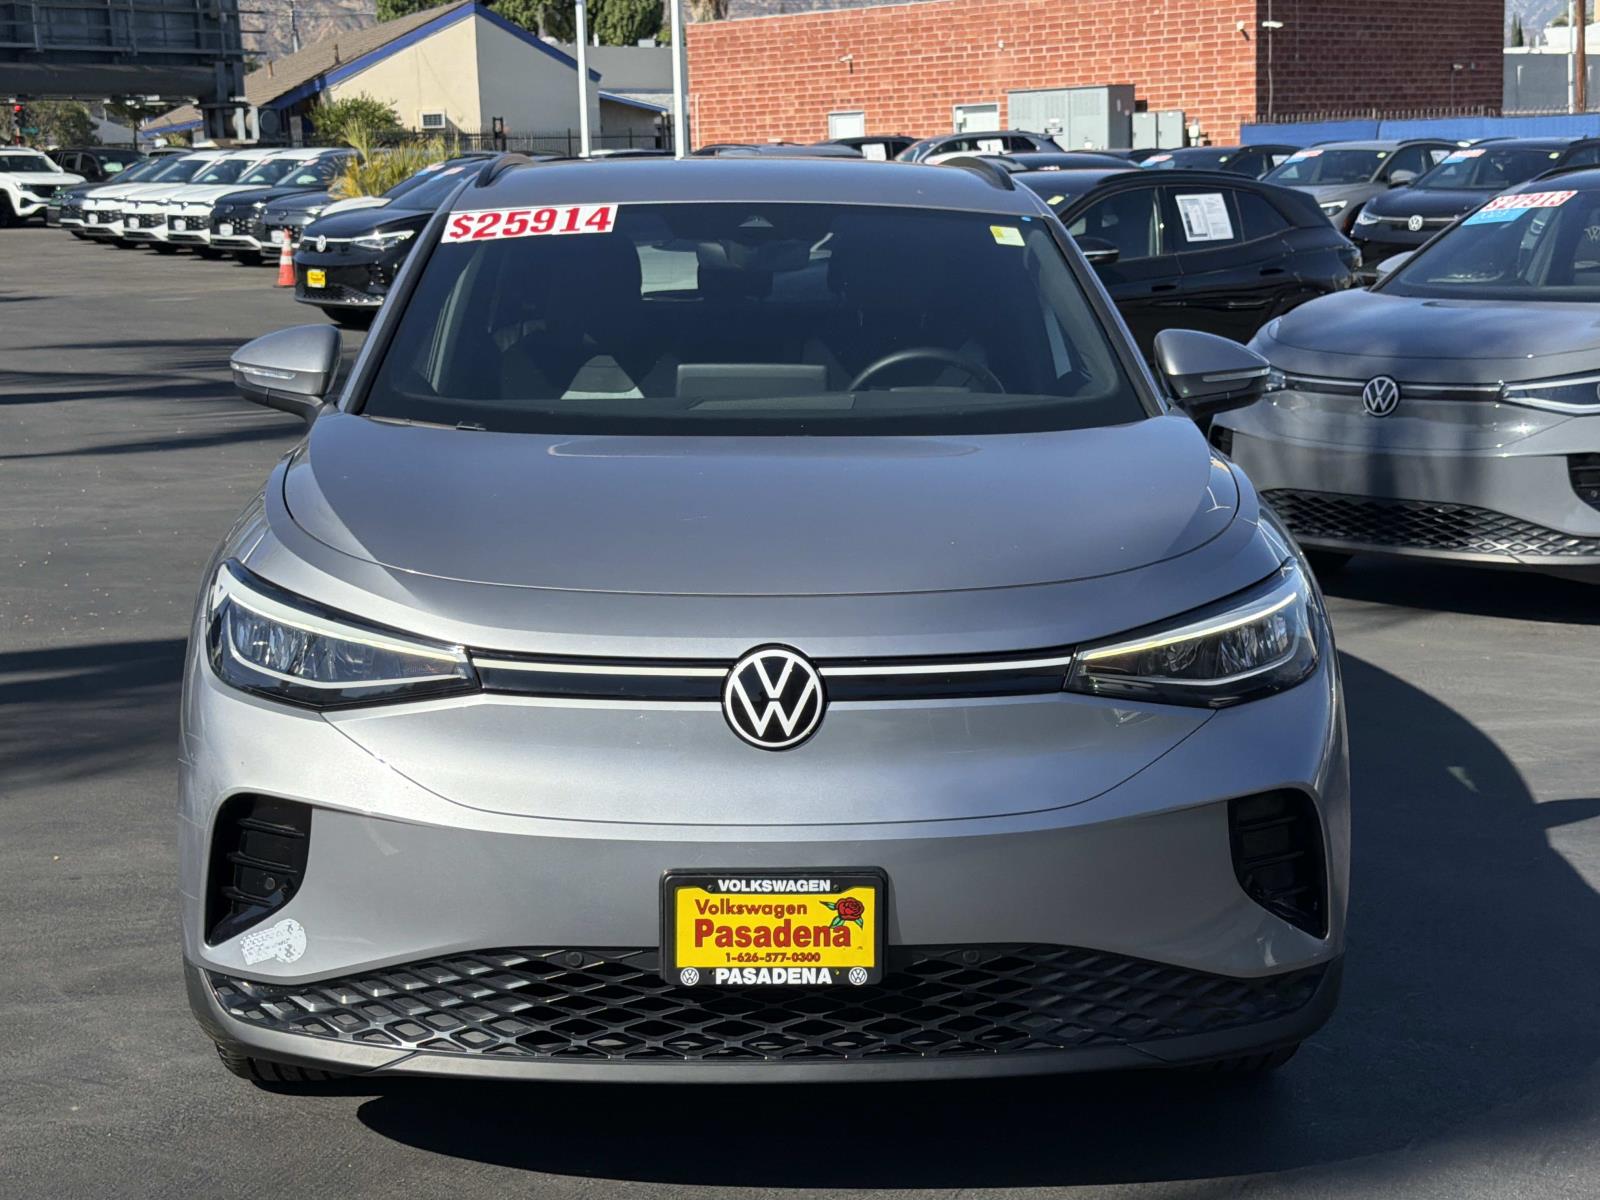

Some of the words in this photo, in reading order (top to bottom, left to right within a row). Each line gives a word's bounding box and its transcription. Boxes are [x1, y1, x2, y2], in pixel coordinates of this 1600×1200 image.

[449, 207, 611, 239] $25914
[727, 651, 820, 745] VW
[718, 879, 831, 892] VOLKSWAGEN
[694, 898, 808, 919] Volkswagen
[694, 918, 851, 948] Pasadena
[725, 952, 821, 963] 1-626-577-0300
[715, 968, 832, 985] PASADENA
